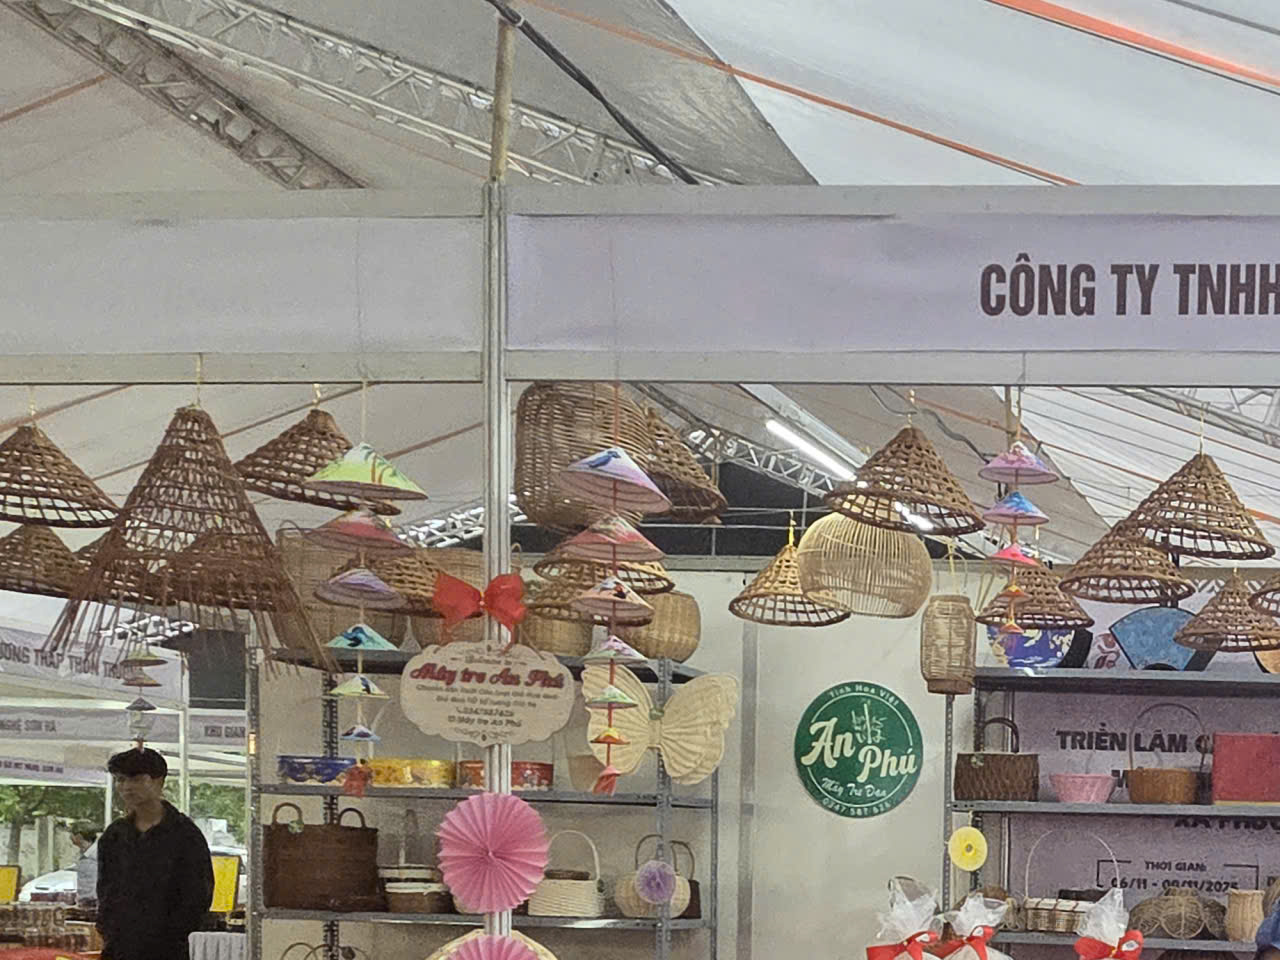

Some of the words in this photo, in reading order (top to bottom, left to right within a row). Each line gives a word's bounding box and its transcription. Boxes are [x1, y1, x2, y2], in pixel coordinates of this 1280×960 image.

[980, 252, 1096, 317] CÔNG
[1110, 263, 1160, 316] TY
[801, 716, 855, 768] An
[1056, 723, 1127, 751] TRIỂN
[1133, 729, 1188, 752] LÃM
[856, 744, 917, 783] Phú
